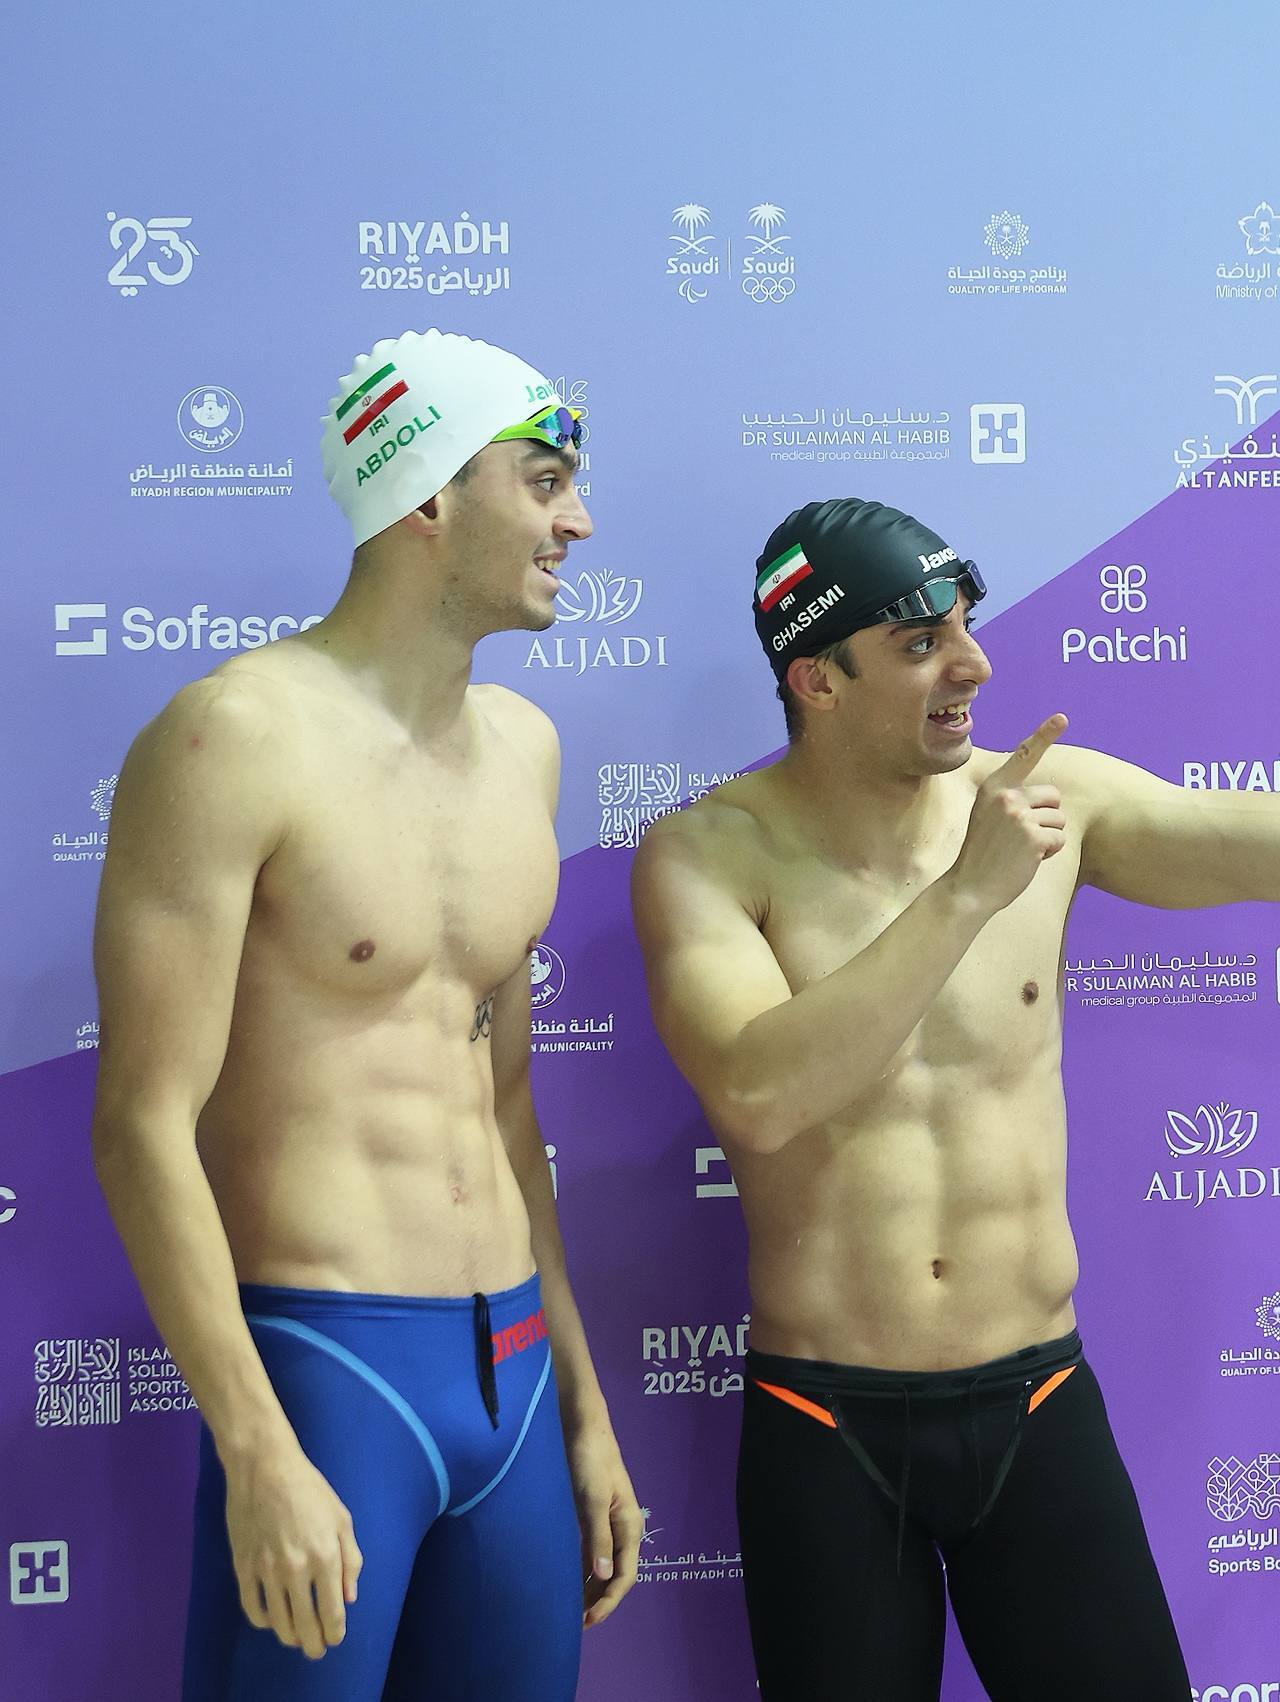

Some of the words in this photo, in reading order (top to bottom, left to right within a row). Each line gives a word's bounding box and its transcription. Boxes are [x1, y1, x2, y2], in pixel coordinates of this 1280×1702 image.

[359, 212, 508, 263] RIYADH
[666, 256, 718, 274] Saudi
[742, 257, 794, 274] Saudi
[948, 266, 990, 282] الحياة
[1216, 262, 1270, 283] الرياضة
[360, 267, 423, 289] 2025
[427, 265, 509, 295] الرياض
[993, 267, 1026, 282] جودة
[1030, 266, 1066, 283] برنامج
[948, 285, 985, 294] QUALITY
[1002, 285, 1020, 293] LIFE
[1023, 285, 1066, 293] PROGRAM
[1216, 284, 1262, 300] Ministry
[1265, 285, 1277, 298] of
[368, 414, 391, 437] IRI
[743, 409, 825, 427] الحبيب
[355, 405, 443, 487] ABDOLI
[743, 432, 767, 445] DR
[773, 431, 864, 445] SULAIMAN
[871, 431, 892, 444] AL
[899, 430, 949, 444] HABIB
[771, 450, 814, 460] medical
[817, 452, 850, 462] group
[130, 464, 186, 483] الرياض
[190, 464, 244, 478] منطقة
[248, 459, 293, 477] أمانة
[131, 488, 170, 496] RIYADH
[174, 487, 214, 496] REGION
[217, 486, 292, 496] MUNICIPALITY
[778, 592, 797, 612] IRI
[120, 603, 326, 651] Sofasc
[771, 584, 846, 653] GHASEMI
[1063, 627, 1186, 662] Patchi
[524, 636, 669, 677] ALJADI
[53, 832, 97, 848] الحياة
[53, 853, 93, 861] QUALITY
[1065, 953, 1136, 975] الحبي
[1083, 974, 1173, 991] SULAIMAN
[1179, 974, 1200, 988] AL
[1206, 973, 1256, 987] HABIB
[1082, 996, 1124, 1006] medical
[1127, 996, 1160, 1007] group
[570, 1014, 613, 1032] أمانة
[77, 1040, 100, 1049] ROY
[540, 1041, 613, 1052] MUNICIPALITY
[491, 1307, 549, 1366] aren
[642, 1314, 749, 1368] RIYA
[1220, 1348, 1261, 1363] الحياة
[1221, 1365, 1257, 1376] QUALITY
[644, 1371, 705, 1394] 2025
[130, 1396, 199, 1413] ASSOCIA
[1208, 1529, 1277, 1552] الرياضي
[657, 1572, 677, 1581] FOR
[683, 1570, 724, 1579] RIYADH
[728, 1568, 744, 1578] CIT
[1209, 1558, 1260, 1576] Sports
